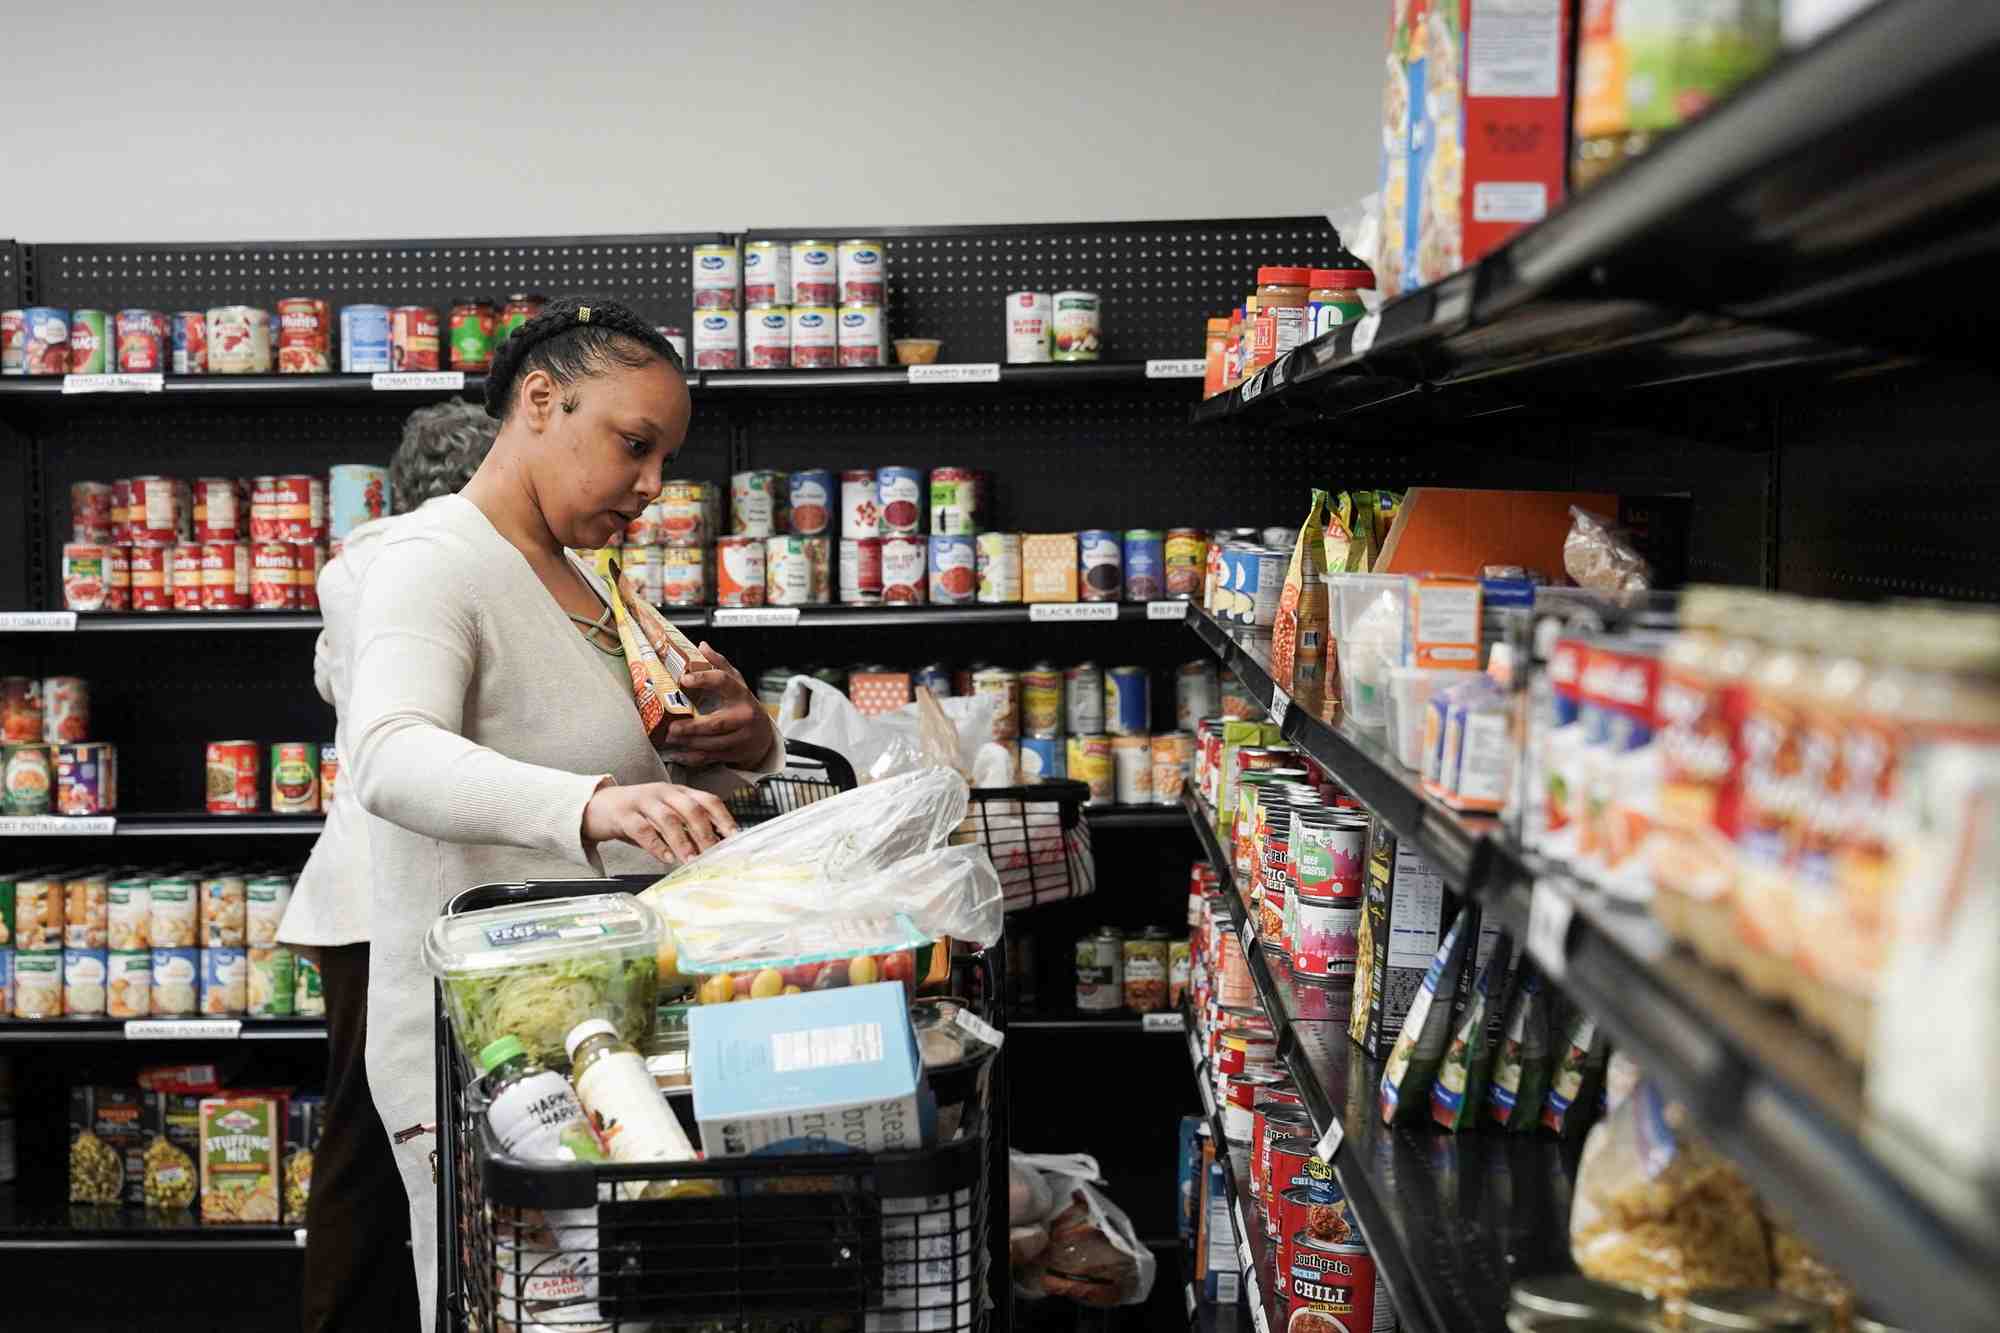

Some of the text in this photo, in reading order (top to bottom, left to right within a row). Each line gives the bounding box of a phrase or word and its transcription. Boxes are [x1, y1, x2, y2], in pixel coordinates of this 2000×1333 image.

[962, 367, 993, 378] FRUIT
[1153, 364, 1187, 375] APPLE
[378, 376, 421, 387] TOMATO
[1035, 606, 1113, 617] BLACK BEANS
[879, 1101, 906, 1146] stea
[1295, 1251, 1350, 1275] Southgate
[1294, 1279, 1345, 1304] CHILI
[1310, 1302, 1326, 1312] with
